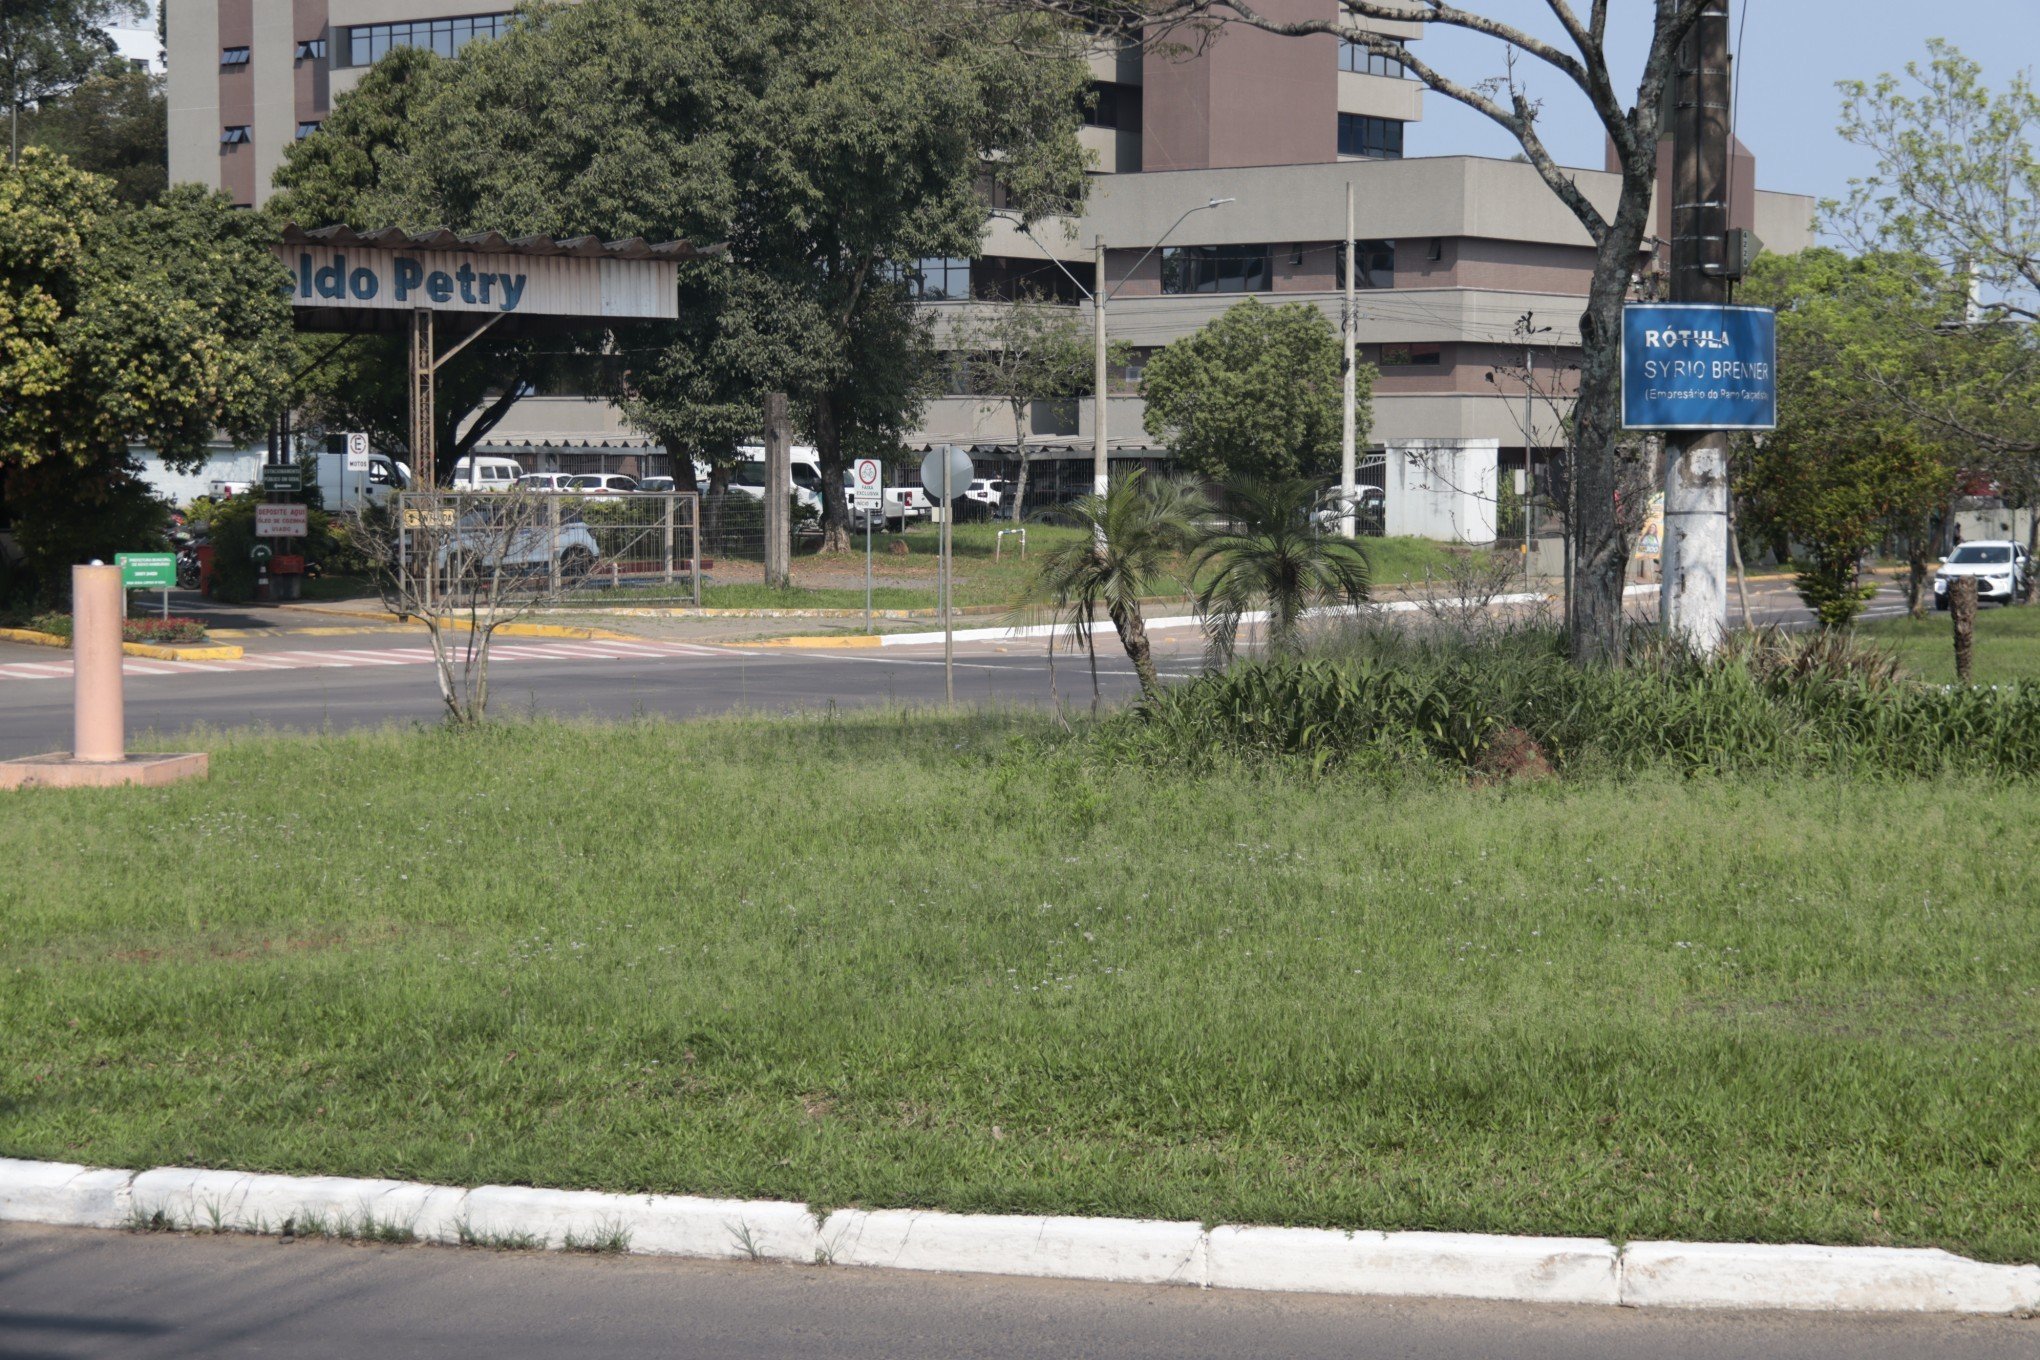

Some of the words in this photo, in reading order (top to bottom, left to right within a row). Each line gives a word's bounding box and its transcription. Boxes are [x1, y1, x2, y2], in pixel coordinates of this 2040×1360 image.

[394, 257, 527, 312] Petry
[1645, 325, 1729, 349] RÓTULA
[1644, 360, 1705, 379] SYRIO
[1712, 361, 1768, 380] BRENNER
[1645, 388, 1705, 401] (Empresário
[1708, 389, 1718, 400] do
[1721, 389, 1739, 399] Ramo
[355, 437, 361, 451] E
